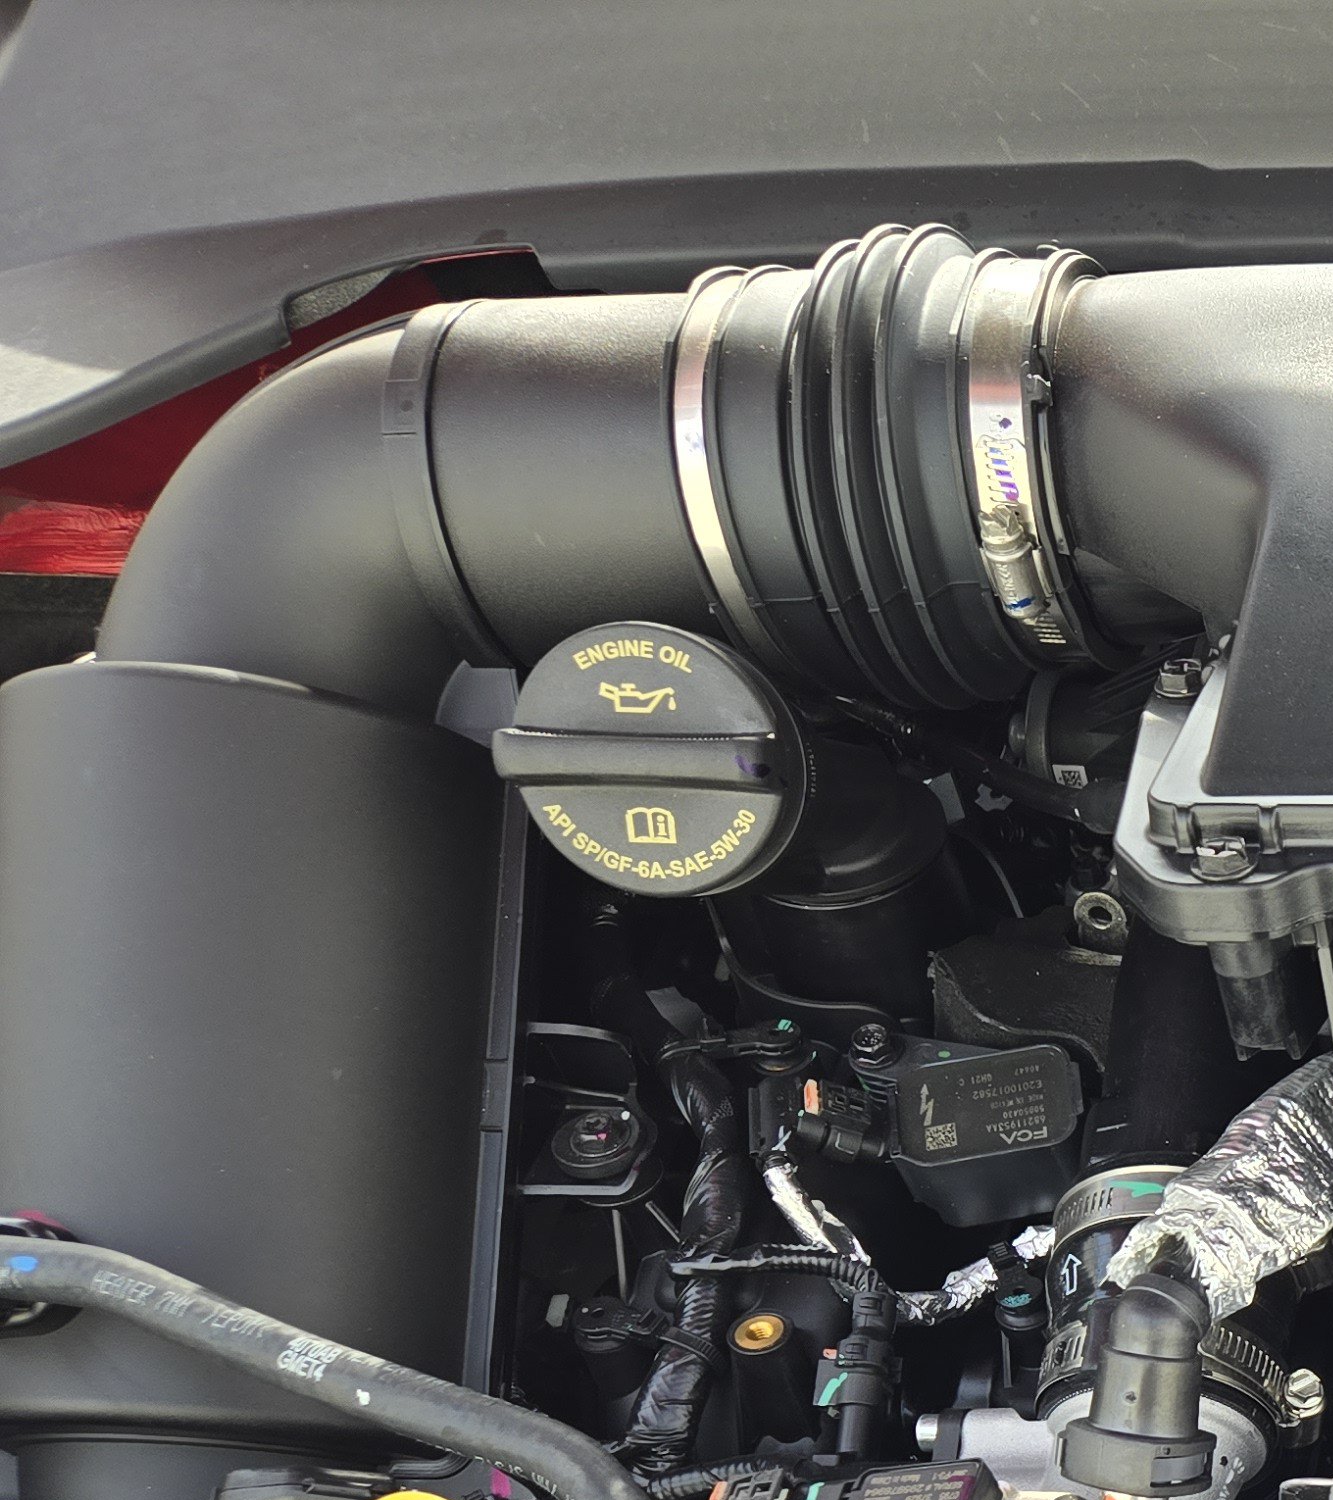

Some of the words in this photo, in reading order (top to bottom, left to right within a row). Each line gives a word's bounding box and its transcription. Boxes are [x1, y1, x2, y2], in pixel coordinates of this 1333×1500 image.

[571, 639, 654, 671] ENGINE
[659, 645, 694, 674] OIL
[542, 803, 577, 837] API
[571, 808, 757, 879] SP/GF-6A-SAE-5W-30
[985, 1115, 1047, 1133] 68211953AA
[999, 1126, 1048, 1145] FCA
[92, 1269, 156, 1307] HEATER
